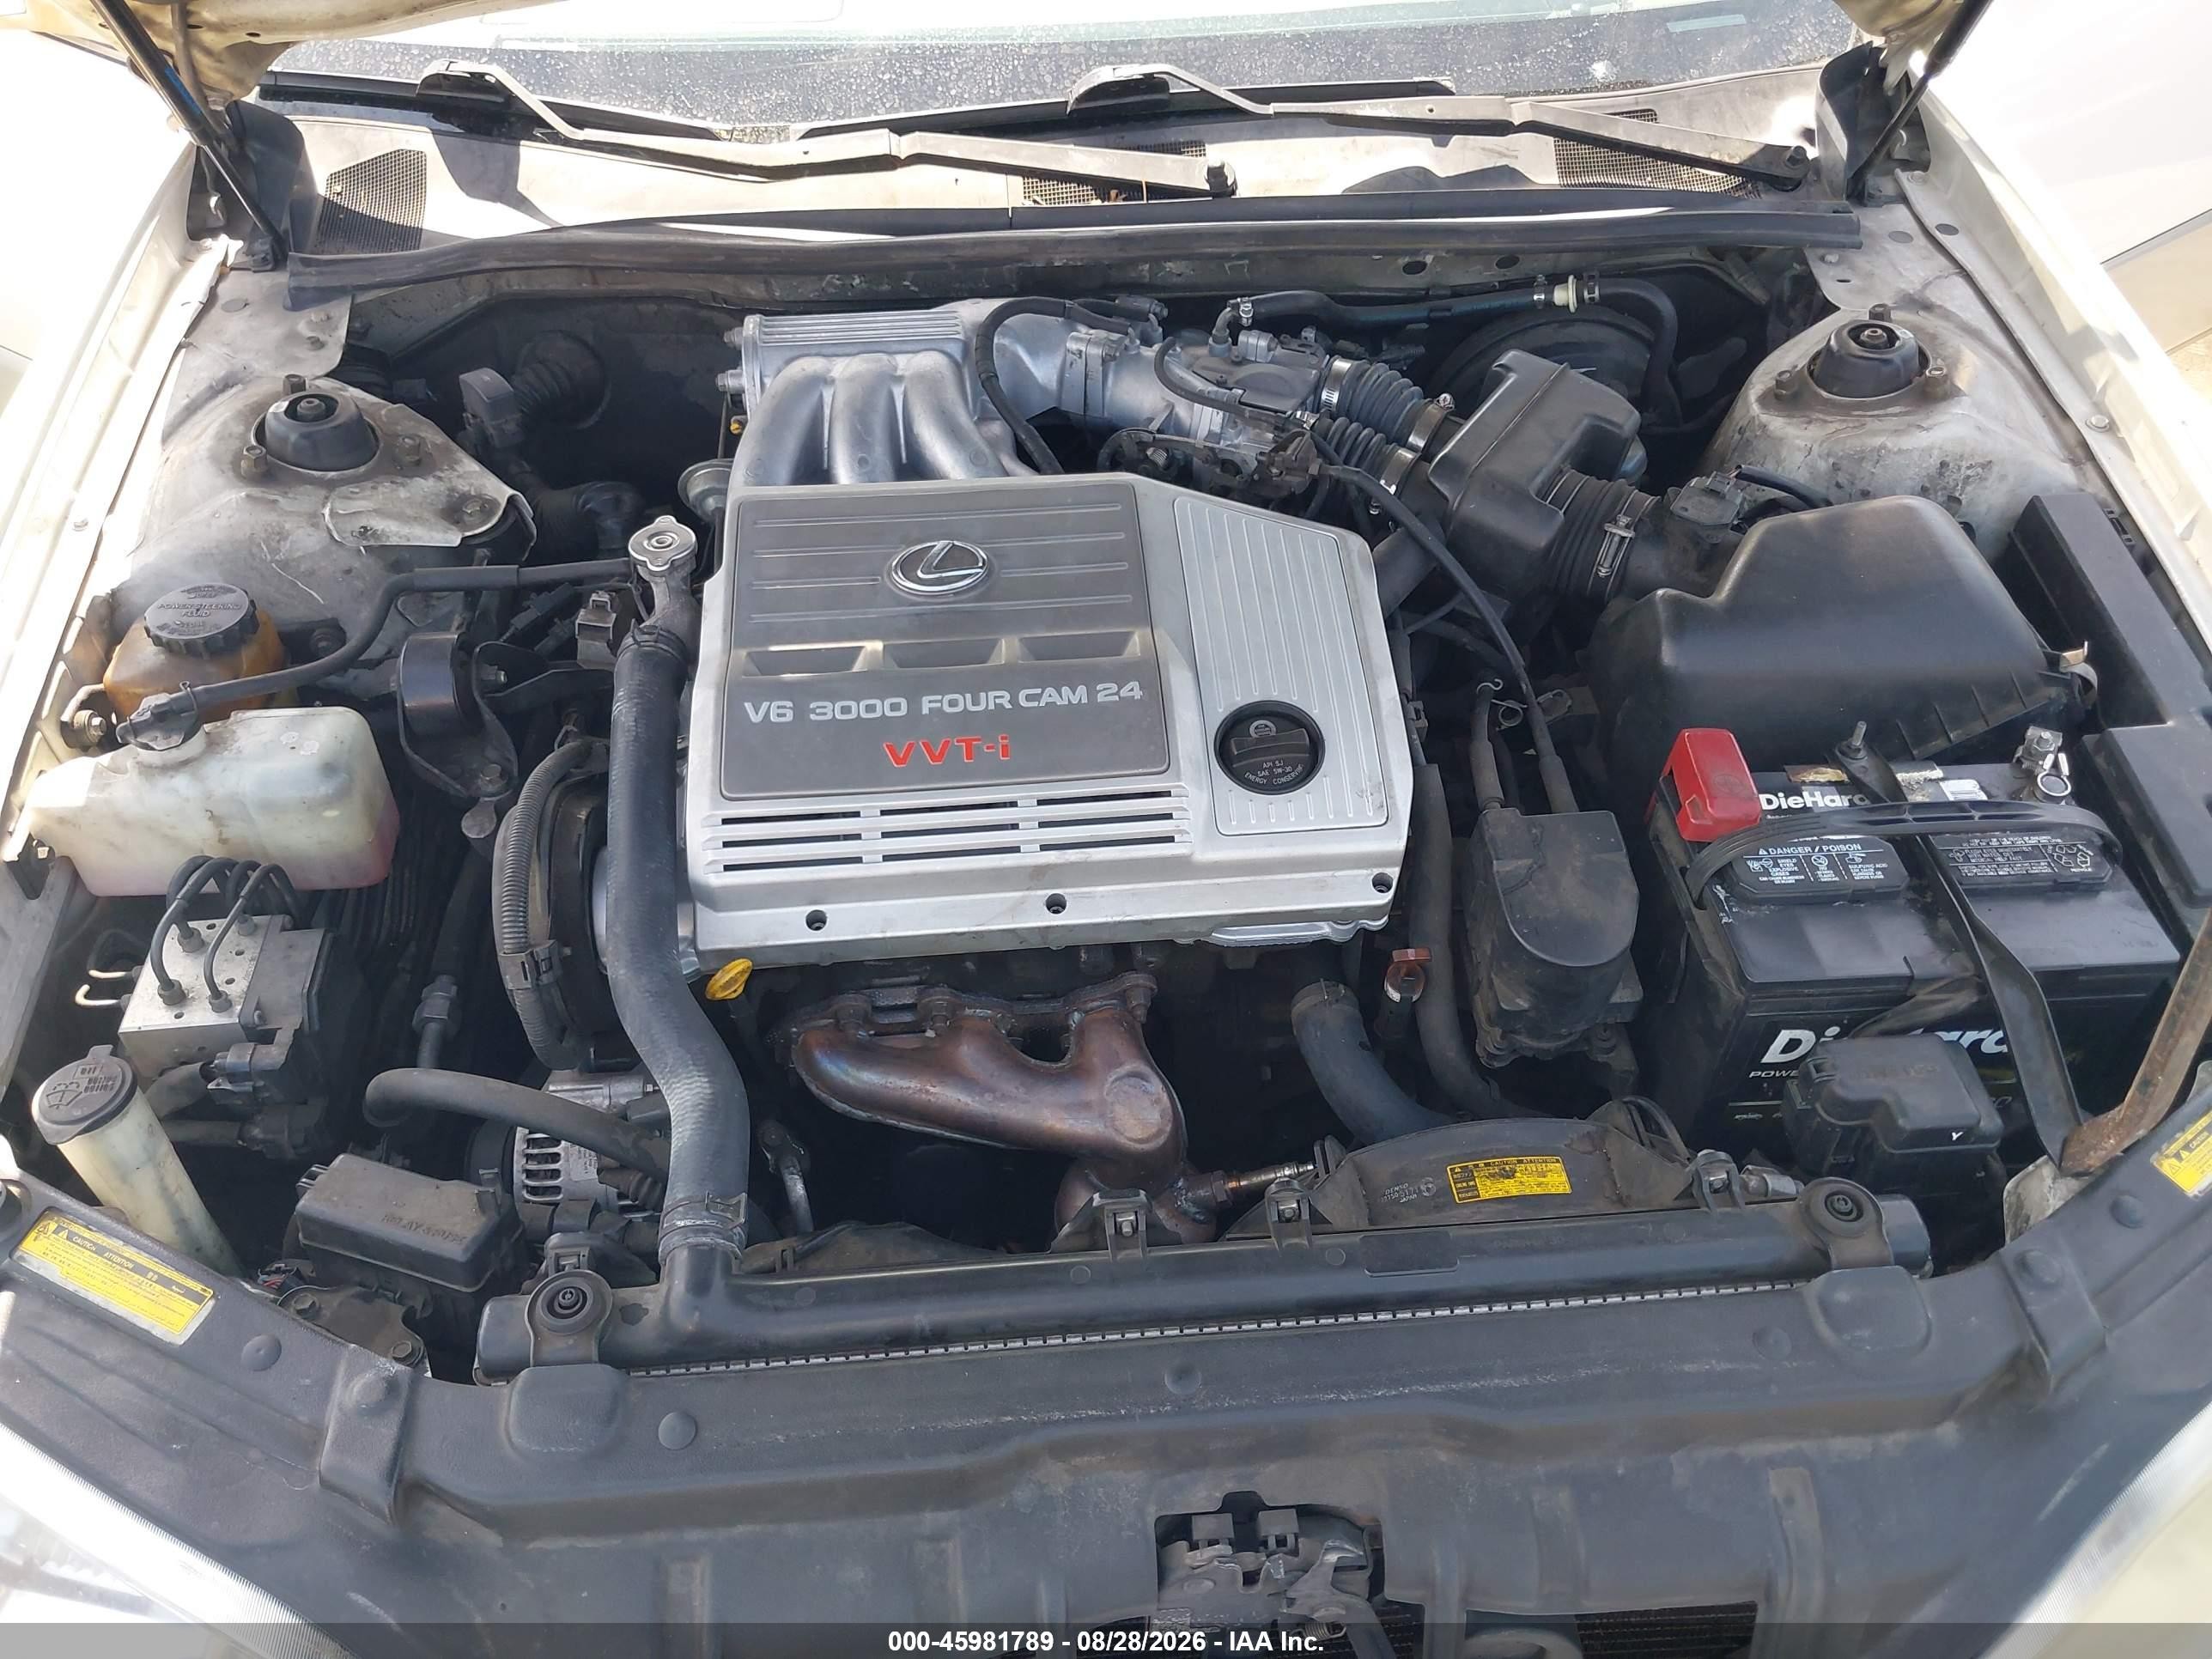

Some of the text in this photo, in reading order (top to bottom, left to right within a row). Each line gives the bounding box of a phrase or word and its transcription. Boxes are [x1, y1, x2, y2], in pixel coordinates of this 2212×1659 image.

[744, 681, 1143, 723] V6 3000 FOUR CAM 24
[883, 734, 1011, 768] VVT-i
[1244, 772, 1267, 784] ENERGY
[1769, 846, 1811, 855] DANGER
[1822, 843, 1862, 853] POISON
[72, 1235, 97, 1252] CAUTION
[104, 1252, 135, 1269] ATTENTION
